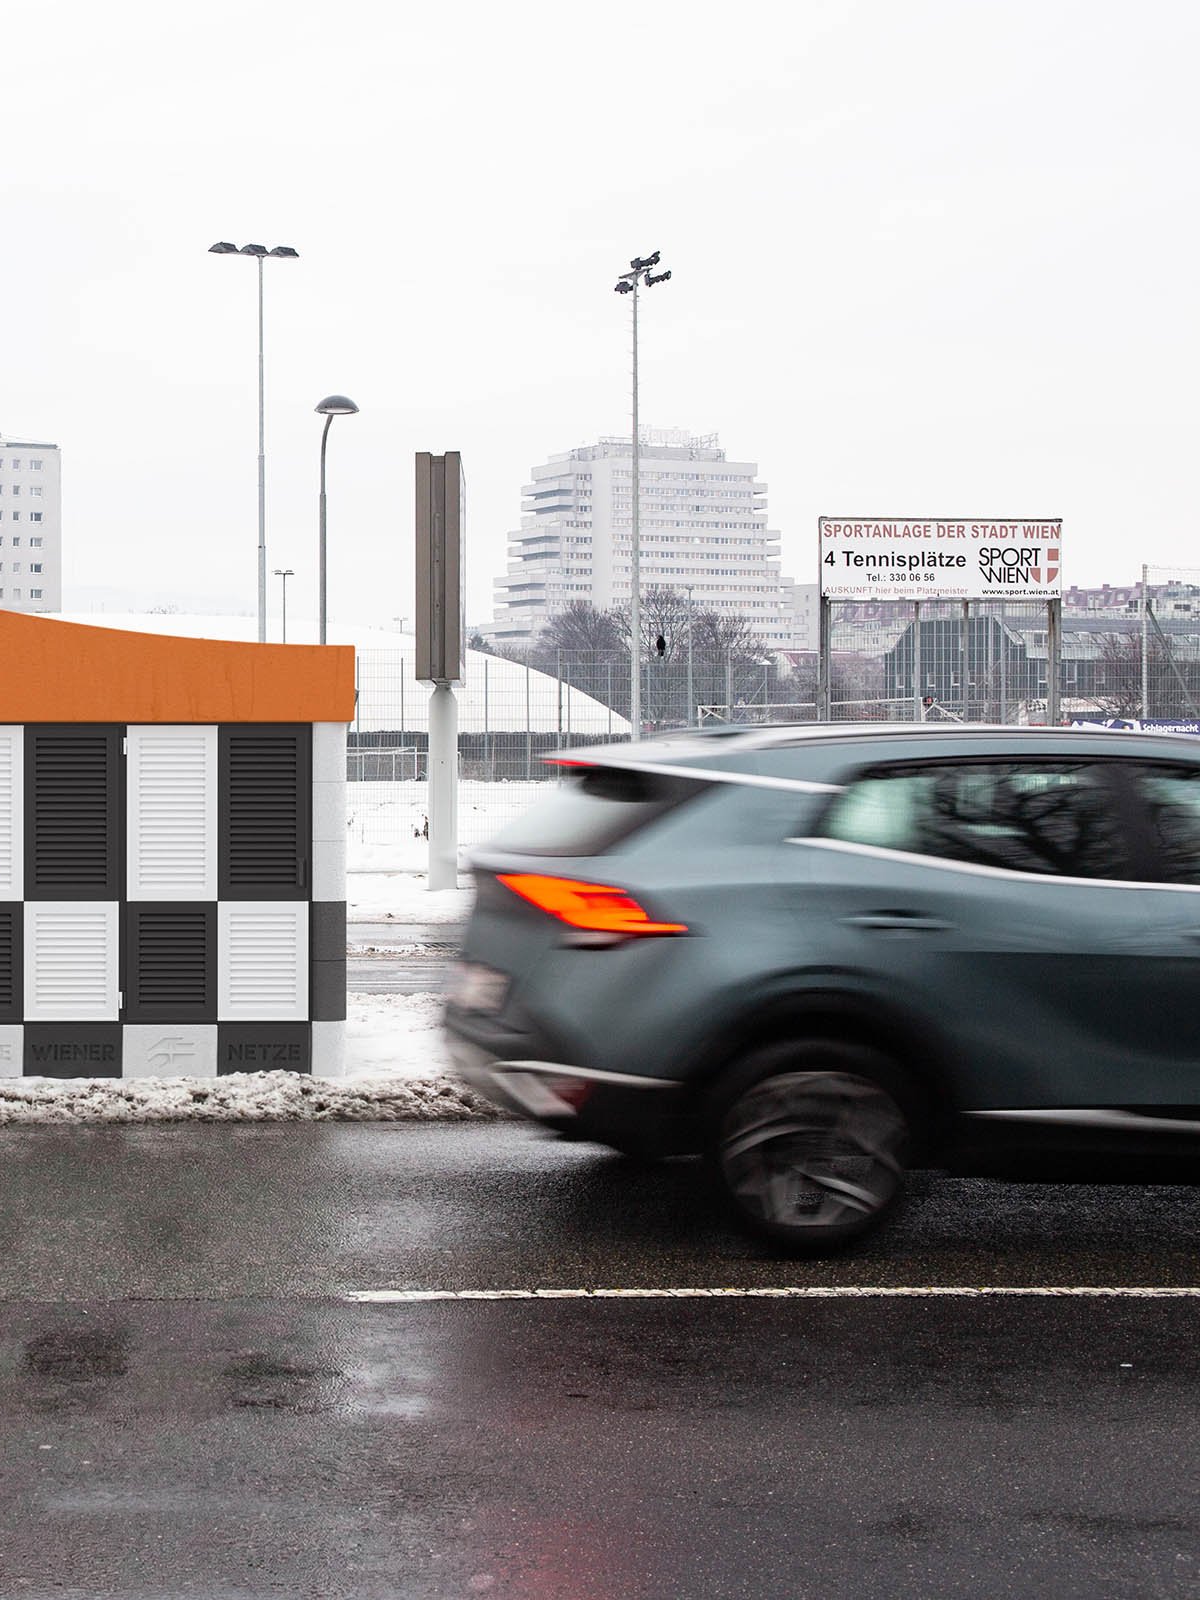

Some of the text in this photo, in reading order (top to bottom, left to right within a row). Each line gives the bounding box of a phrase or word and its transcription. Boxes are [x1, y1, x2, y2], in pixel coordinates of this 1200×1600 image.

[823, 524, 1060, 539] SPORTANLAGE DER STADT WIEN
[824, 550, 966, 571] 4 Tennisplätze
[979, 547, 1041, 567] SPORT
[866, 573, 935, 582] Tel.: 330 06 56
[979, 567, 1029, 583] WIEN
[825, 586, 872, 594] AUSKUNFT
[917, 586, 968, 595] Platzmeister
[982, 588, 1059, 596] www.sport.wien.at
[31, 1044, 301, 1061] WIENER NETZE
